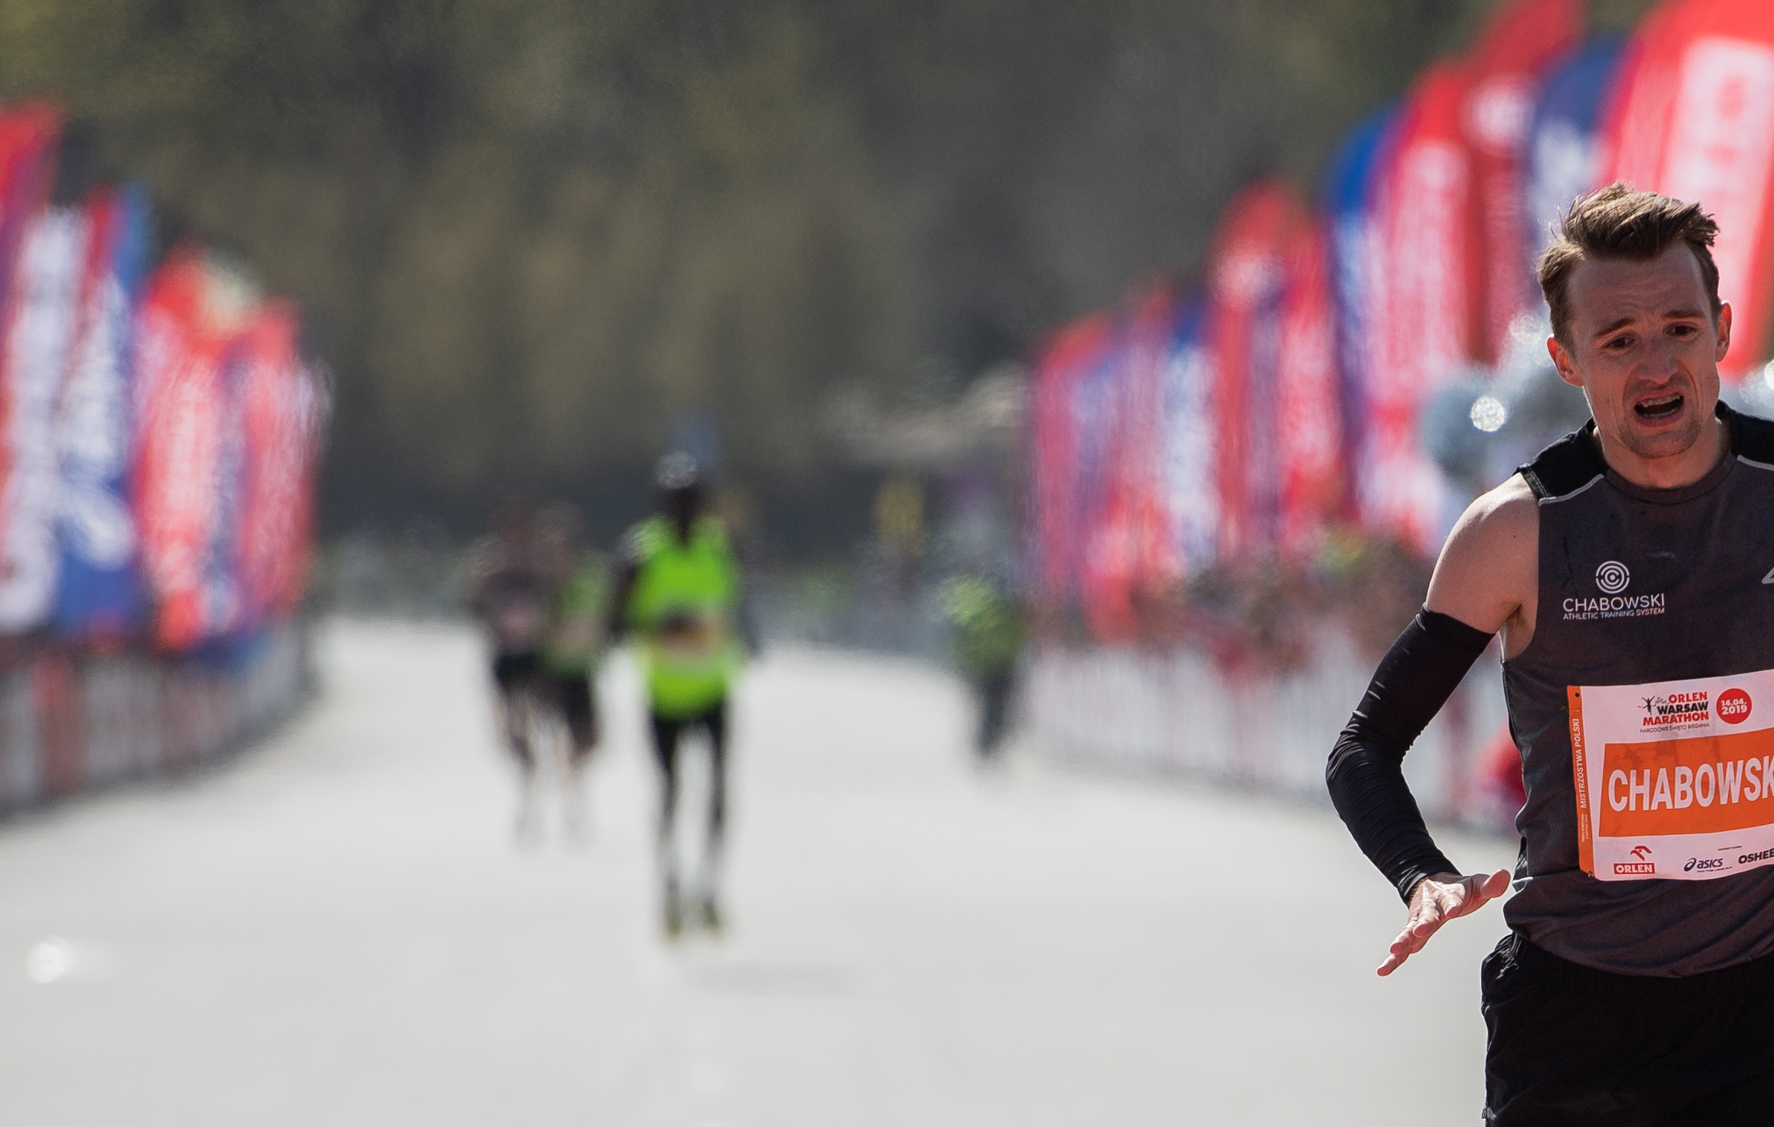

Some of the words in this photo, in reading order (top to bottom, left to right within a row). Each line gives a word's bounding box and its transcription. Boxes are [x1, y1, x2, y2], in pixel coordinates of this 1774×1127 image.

[1562, 593, 1665, 612] CHABOWSKI
[1562, 611, 1599, 620] ATHLETIC
[1600, 609, 1635, 619] TRAINING
[1636, 607, 1665, 617] SYSTEM
[1668, 691, 1708, 704] ORLEN
[1657, 701, 1709, 715] WARSAW
[1722, 704, 1748, 715] 2019
[1642, 711, 1709, 726] MARATHON
[1573, 718, 1582, 748] POLSKI
[1574, 749, 1587, 809] MISTRZOSTWA
[1615, 864, 1653, 874] ORLEN
